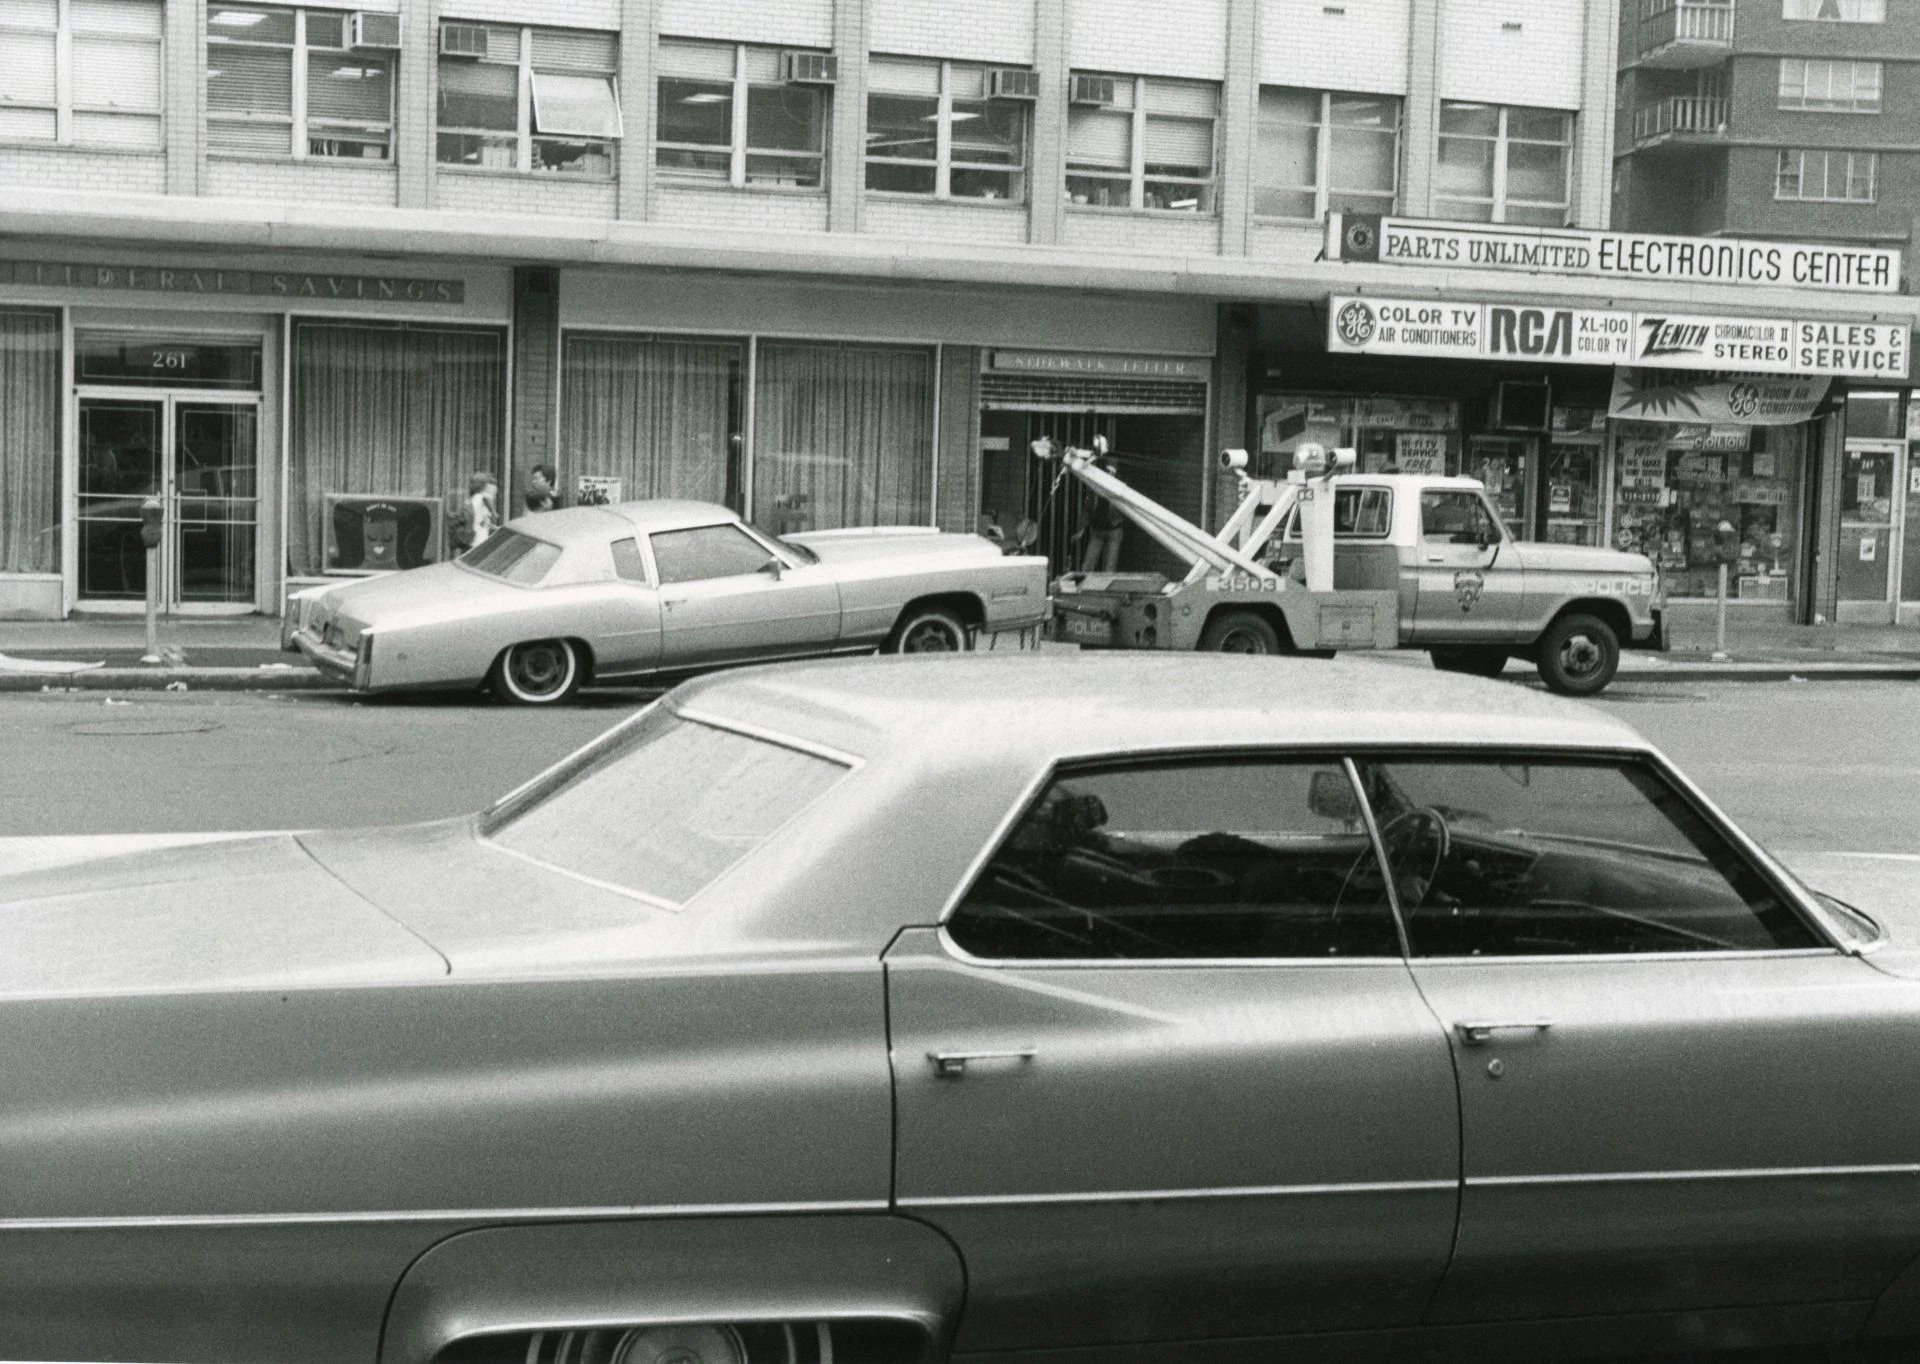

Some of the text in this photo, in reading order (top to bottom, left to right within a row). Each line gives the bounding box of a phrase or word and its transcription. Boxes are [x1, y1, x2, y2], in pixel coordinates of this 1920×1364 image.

[1386, 235, 1889, 286] PARTS UNLIMITED ELECTRONICS CENTER
[273, 274, 451, 300] SAVINGS
[1379, 306, 1476, 326] COLOR TV
[1579, 316, 1628, 333] XL-100
[1378, 327, 1477, 346] AIR CONDITIONERS
[1490, 308, 1573, 356] RCA
[1640, 318, 1710, 358] ZENITH
[1801, 325, 1901, 348] SALES &
[1578, 337, 1628, 353] COLOR TV
[1714, 344, 1788, 361] STEREO
[152, 351, 185, 368] 261
[1801, 348, 1901, 371] SERVICE
[1218, 578, 1276, 592] 3503
